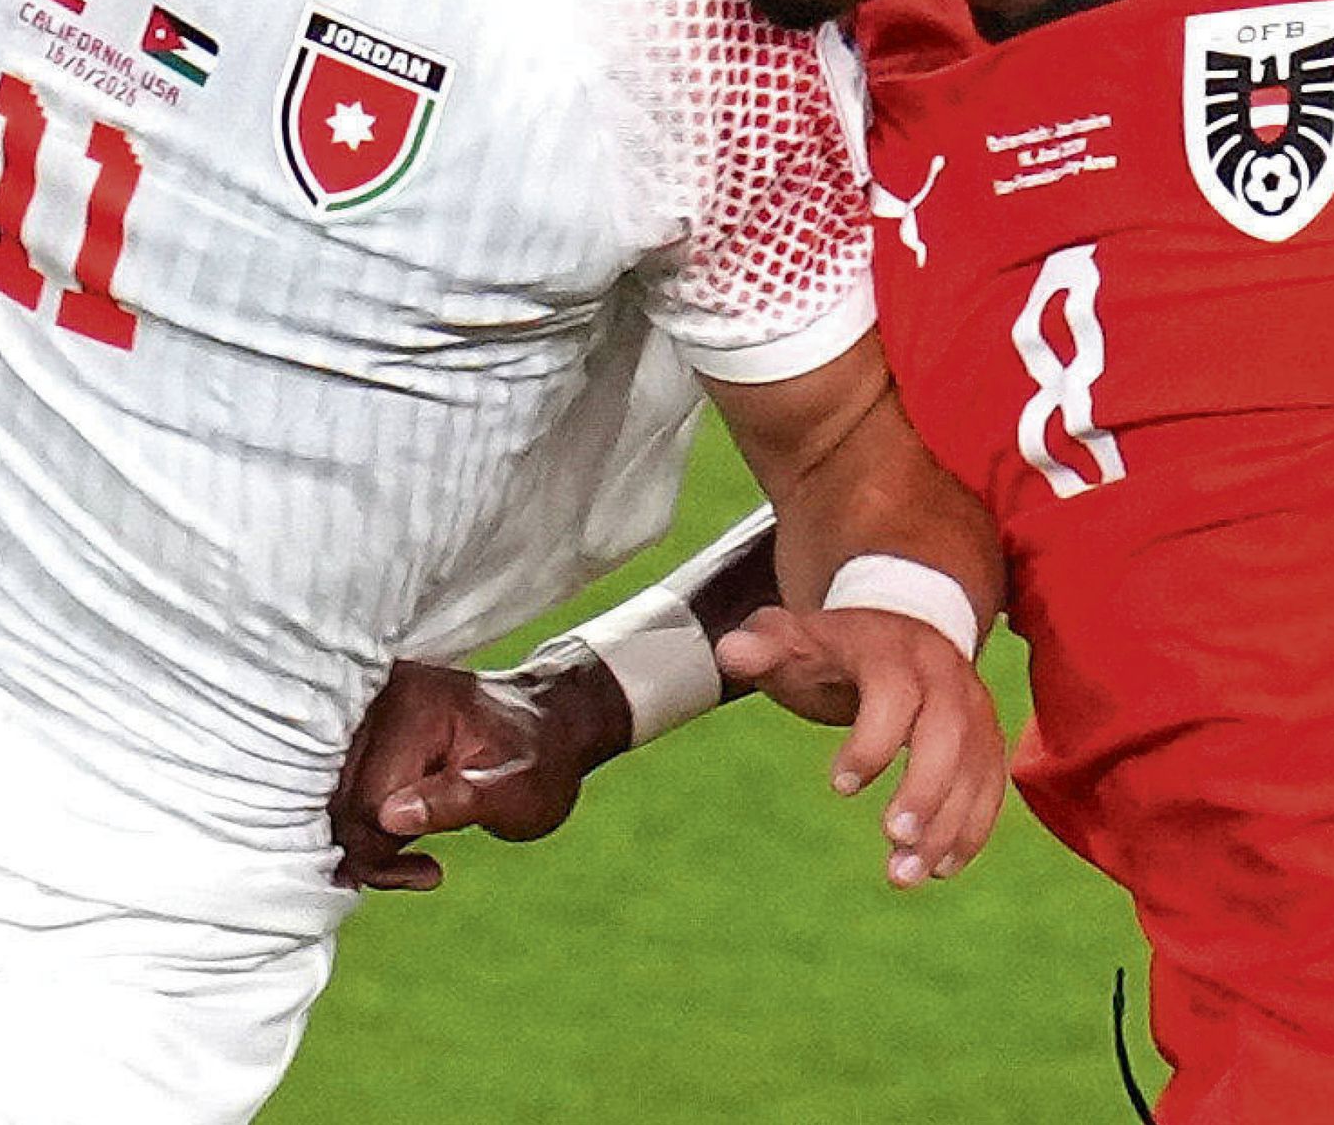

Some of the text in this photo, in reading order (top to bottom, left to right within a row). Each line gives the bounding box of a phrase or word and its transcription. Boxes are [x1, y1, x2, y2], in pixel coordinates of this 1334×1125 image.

[321, 23, 432, 83] JORDAN
[141, 70, 181, 106] USA
[1011, 243, 1127, 499] 8
